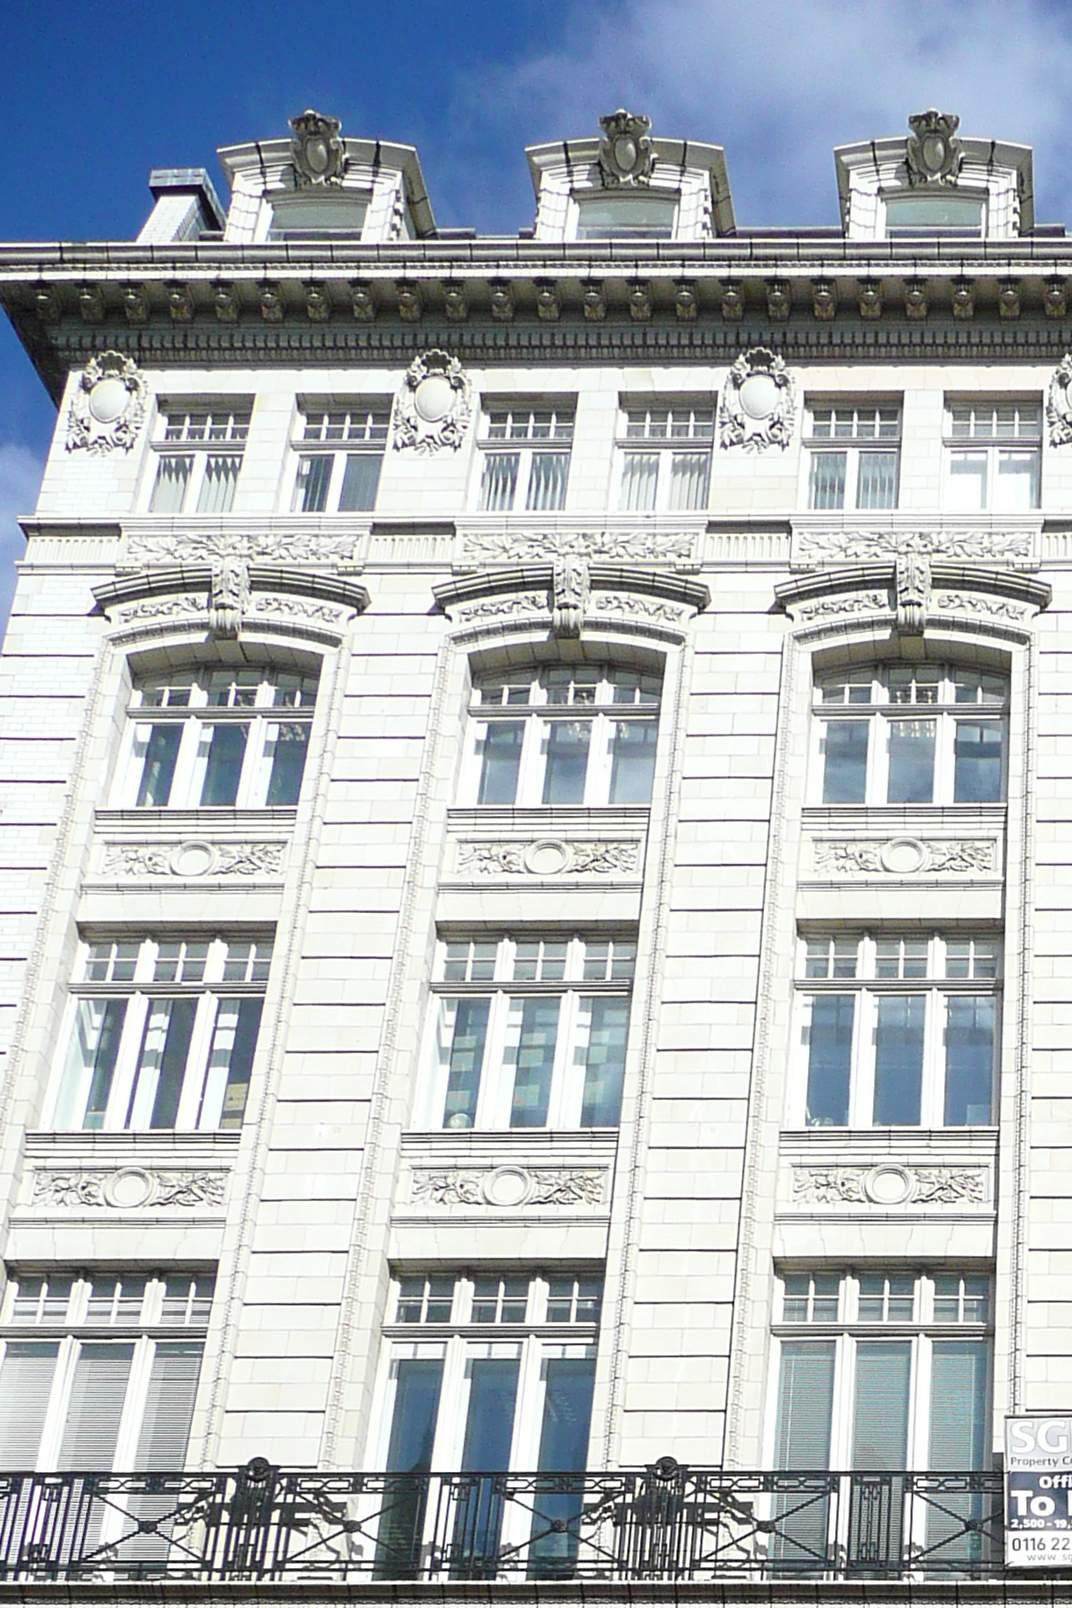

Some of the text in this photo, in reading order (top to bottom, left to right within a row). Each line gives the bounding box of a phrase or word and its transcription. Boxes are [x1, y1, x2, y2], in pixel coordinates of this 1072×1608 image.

[1010, 1456, 1059, 1467] Property
[1010, 1490, 1056, 1517] To
[1010, 1519, 1045, 1529] 2,500
[1012, 1537, 1046, 1551] 0116
[1051, 1537, 1071, 1551] 22
